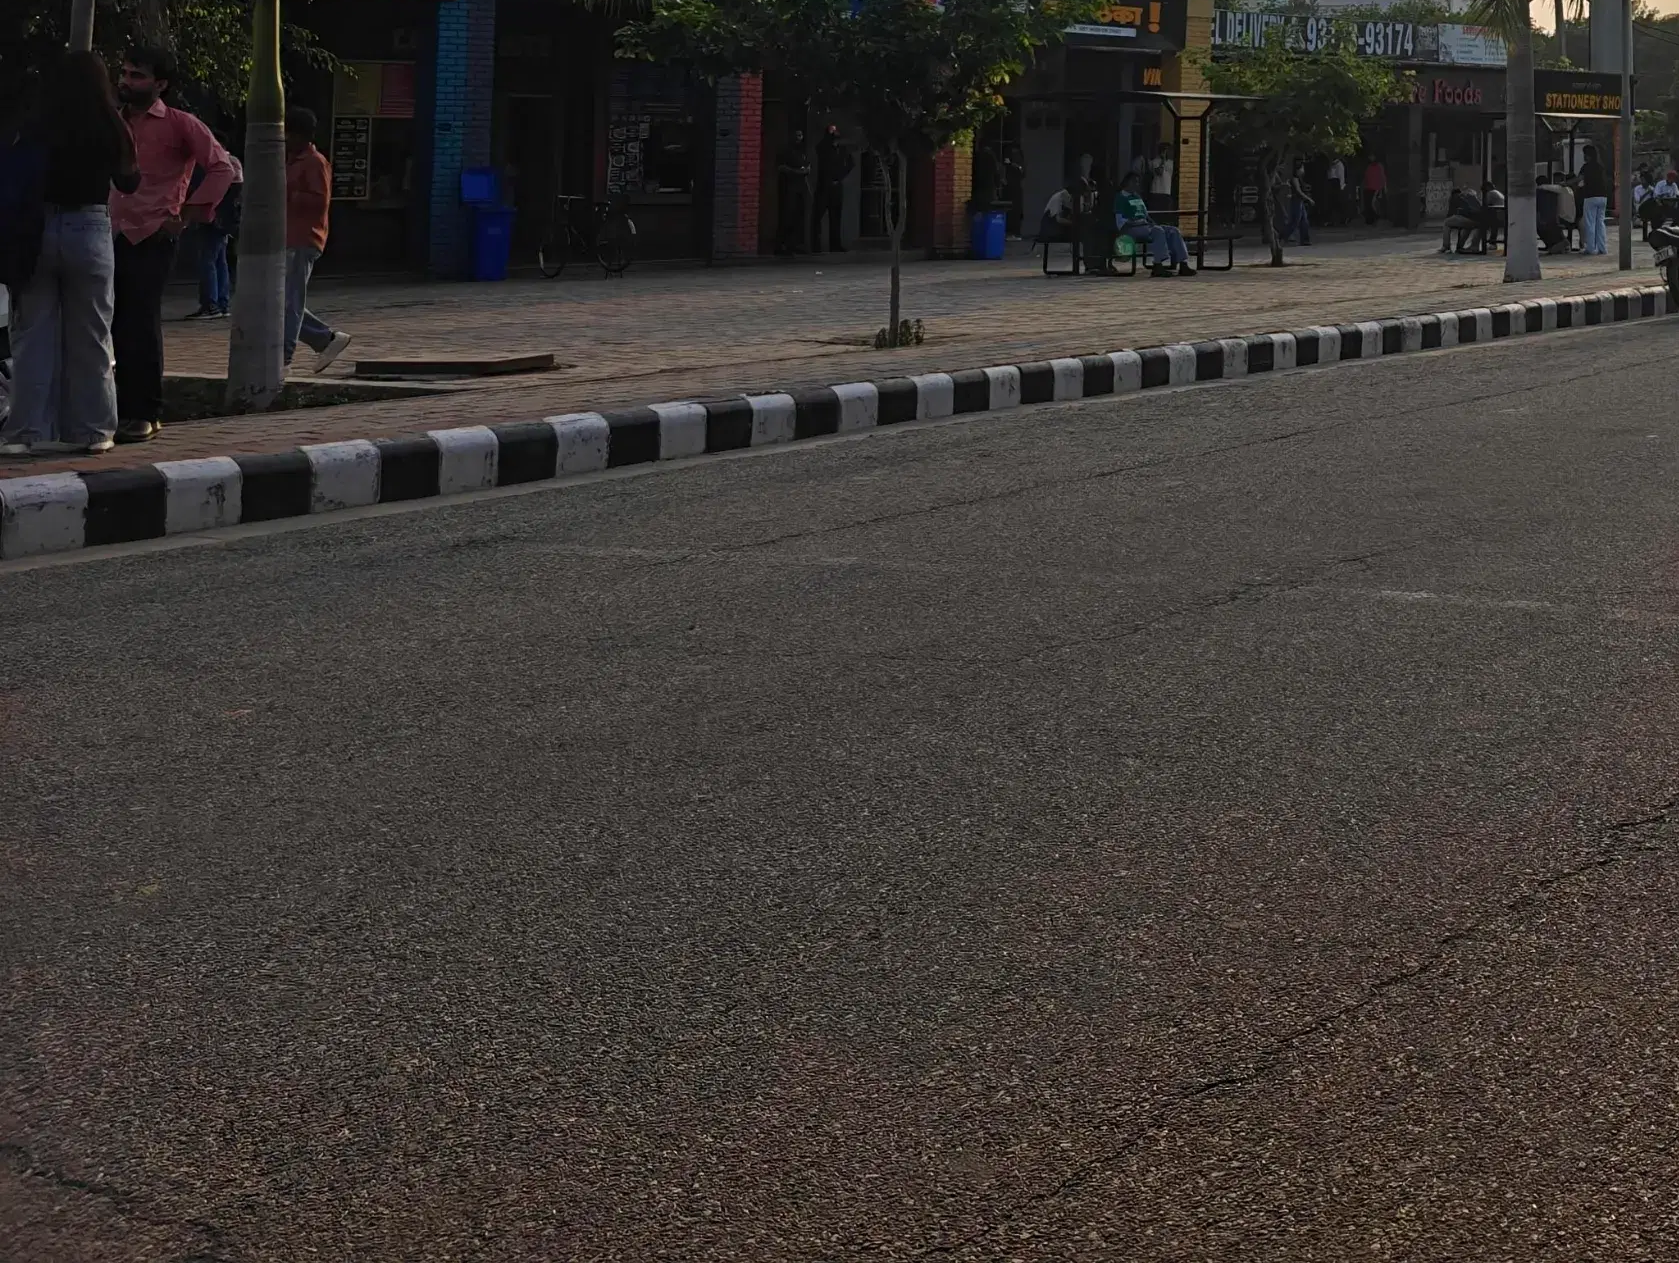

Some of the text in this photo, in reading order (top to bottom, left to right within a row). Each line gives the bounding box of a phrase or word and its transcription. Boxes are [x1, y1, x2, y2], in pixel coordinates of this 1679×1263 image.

[1306, 17, 1414, 56] 93-93174
[1433, 78, 1483, 106] Foods
[1545, 93, 1623, 110] STATIONERY SHO
